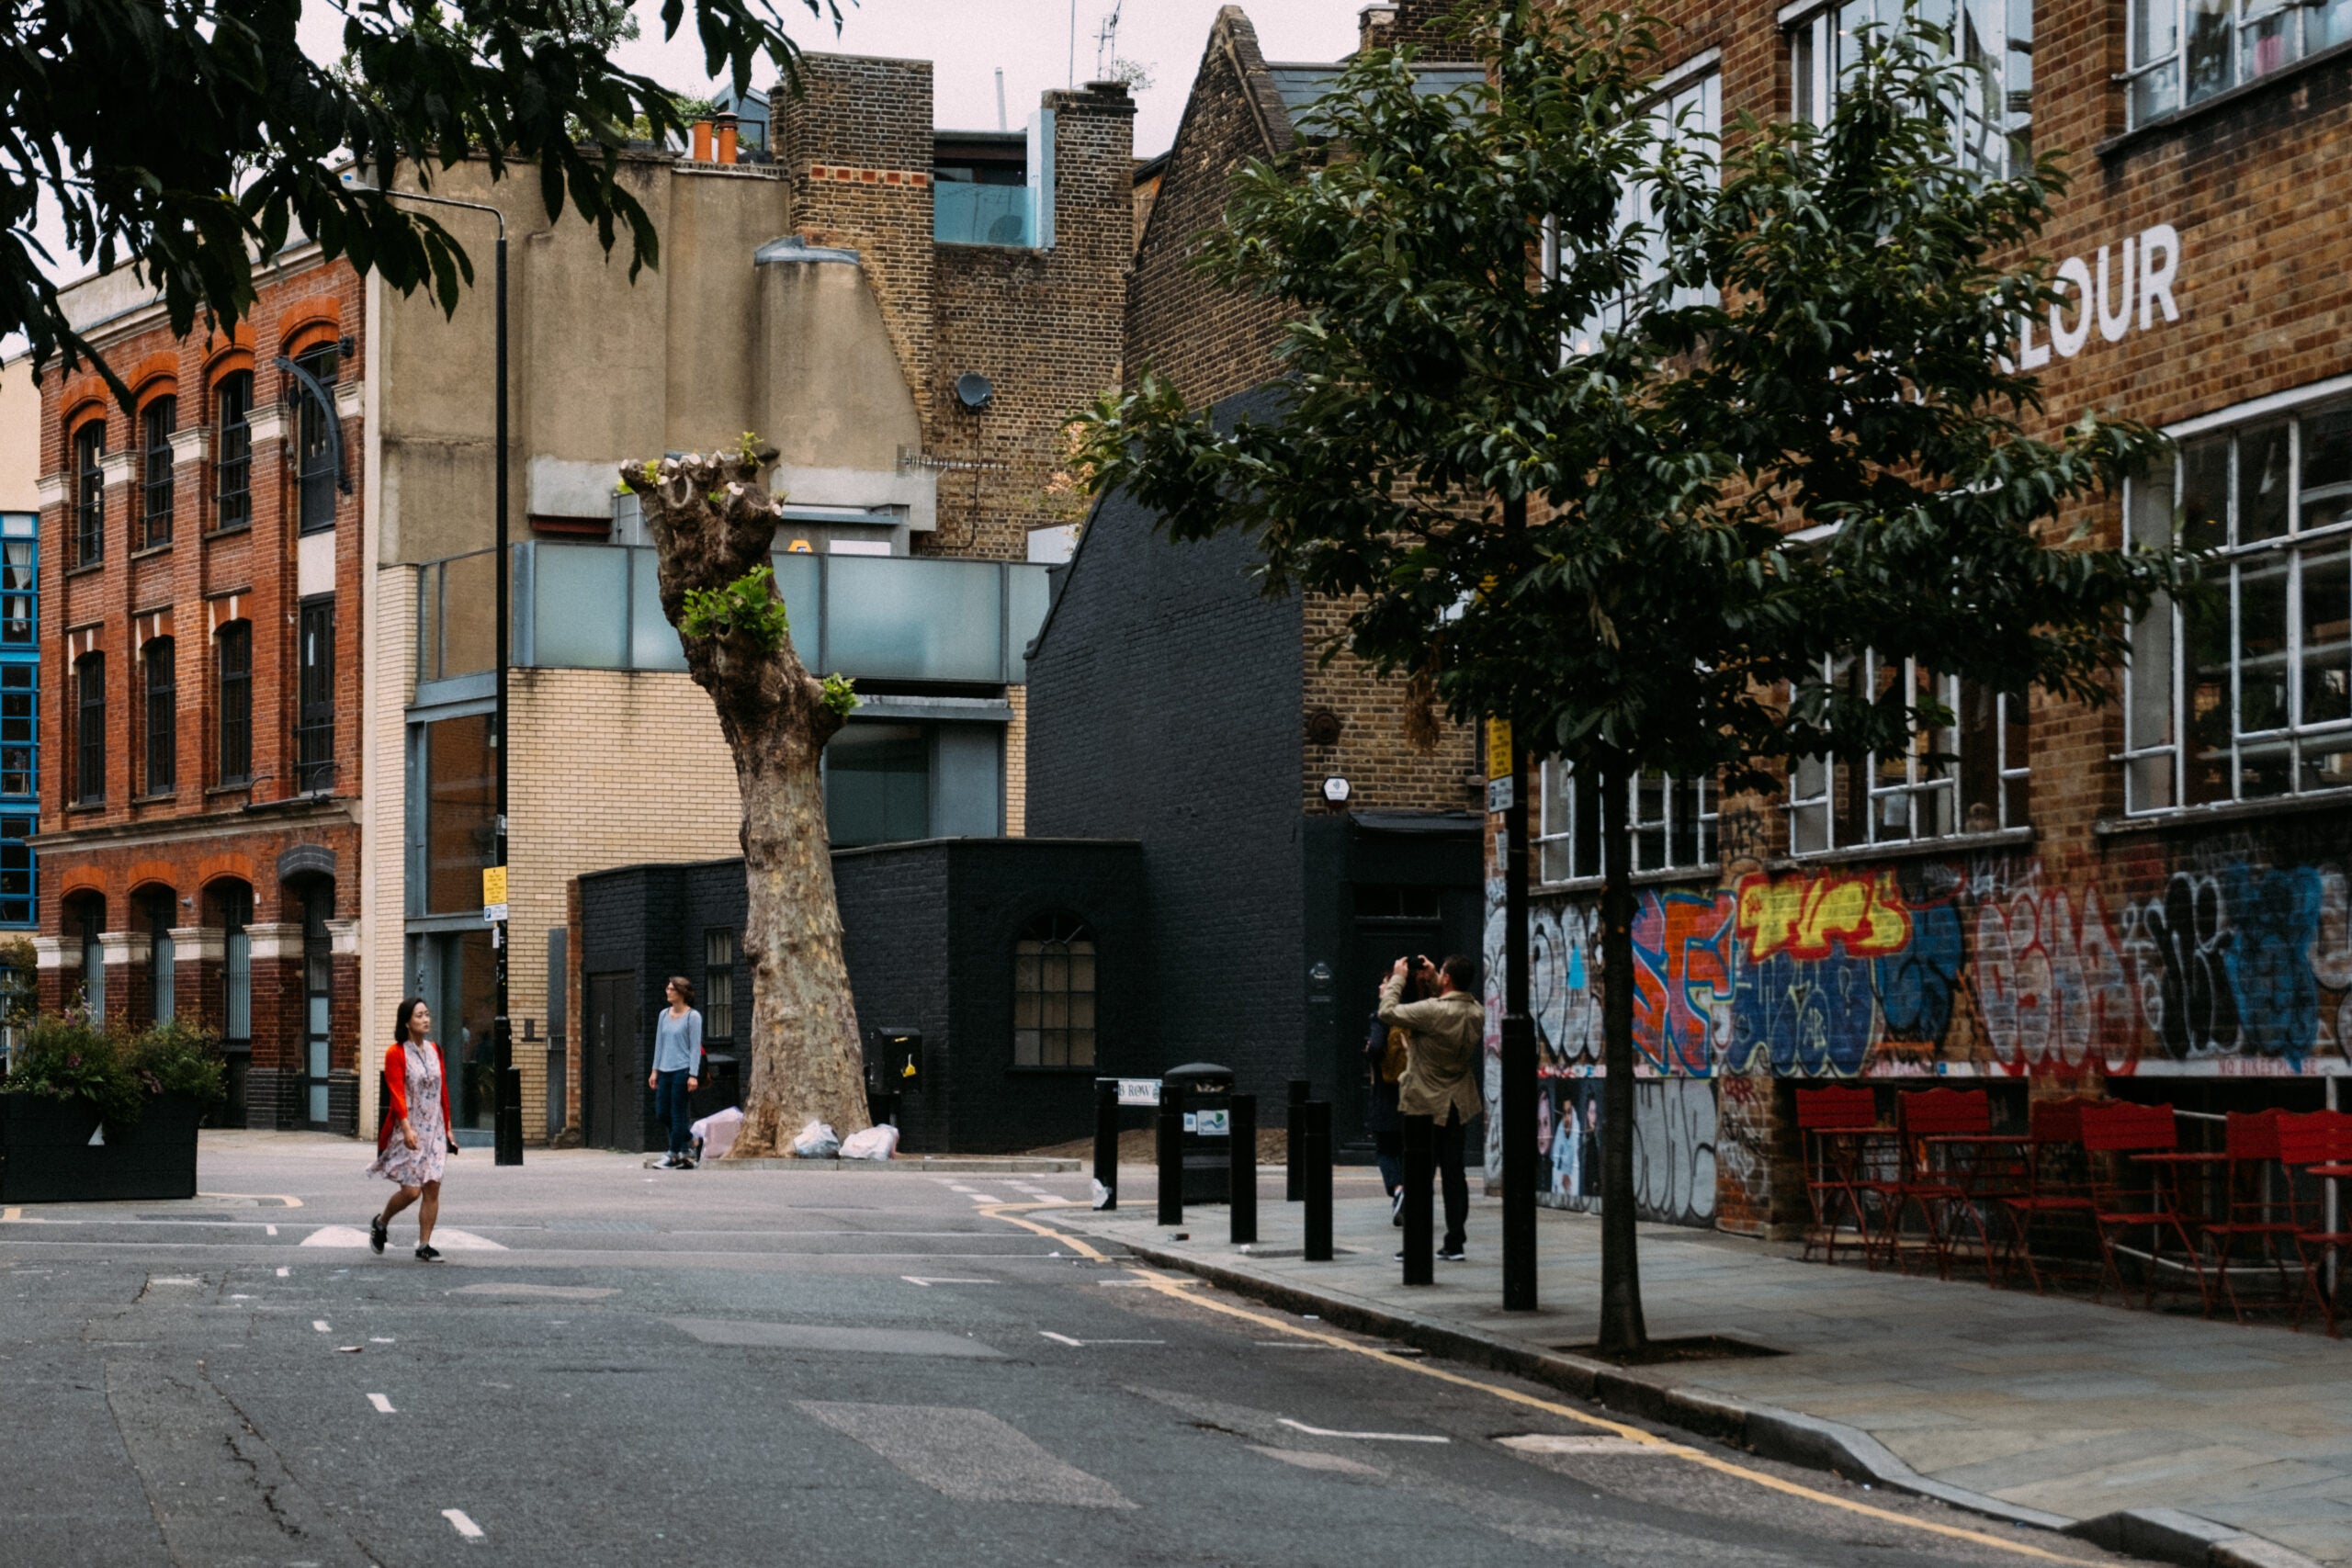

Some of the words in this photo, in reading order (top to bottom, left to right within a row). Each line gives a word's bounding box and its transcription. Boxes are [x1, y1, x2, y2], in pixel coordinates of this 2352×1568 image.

[2218, 1057, 2234, 1075] NO
[2241, 1057, 2272, 1075] BIKES
[1128, 1085, 1151, 1096] ROW
